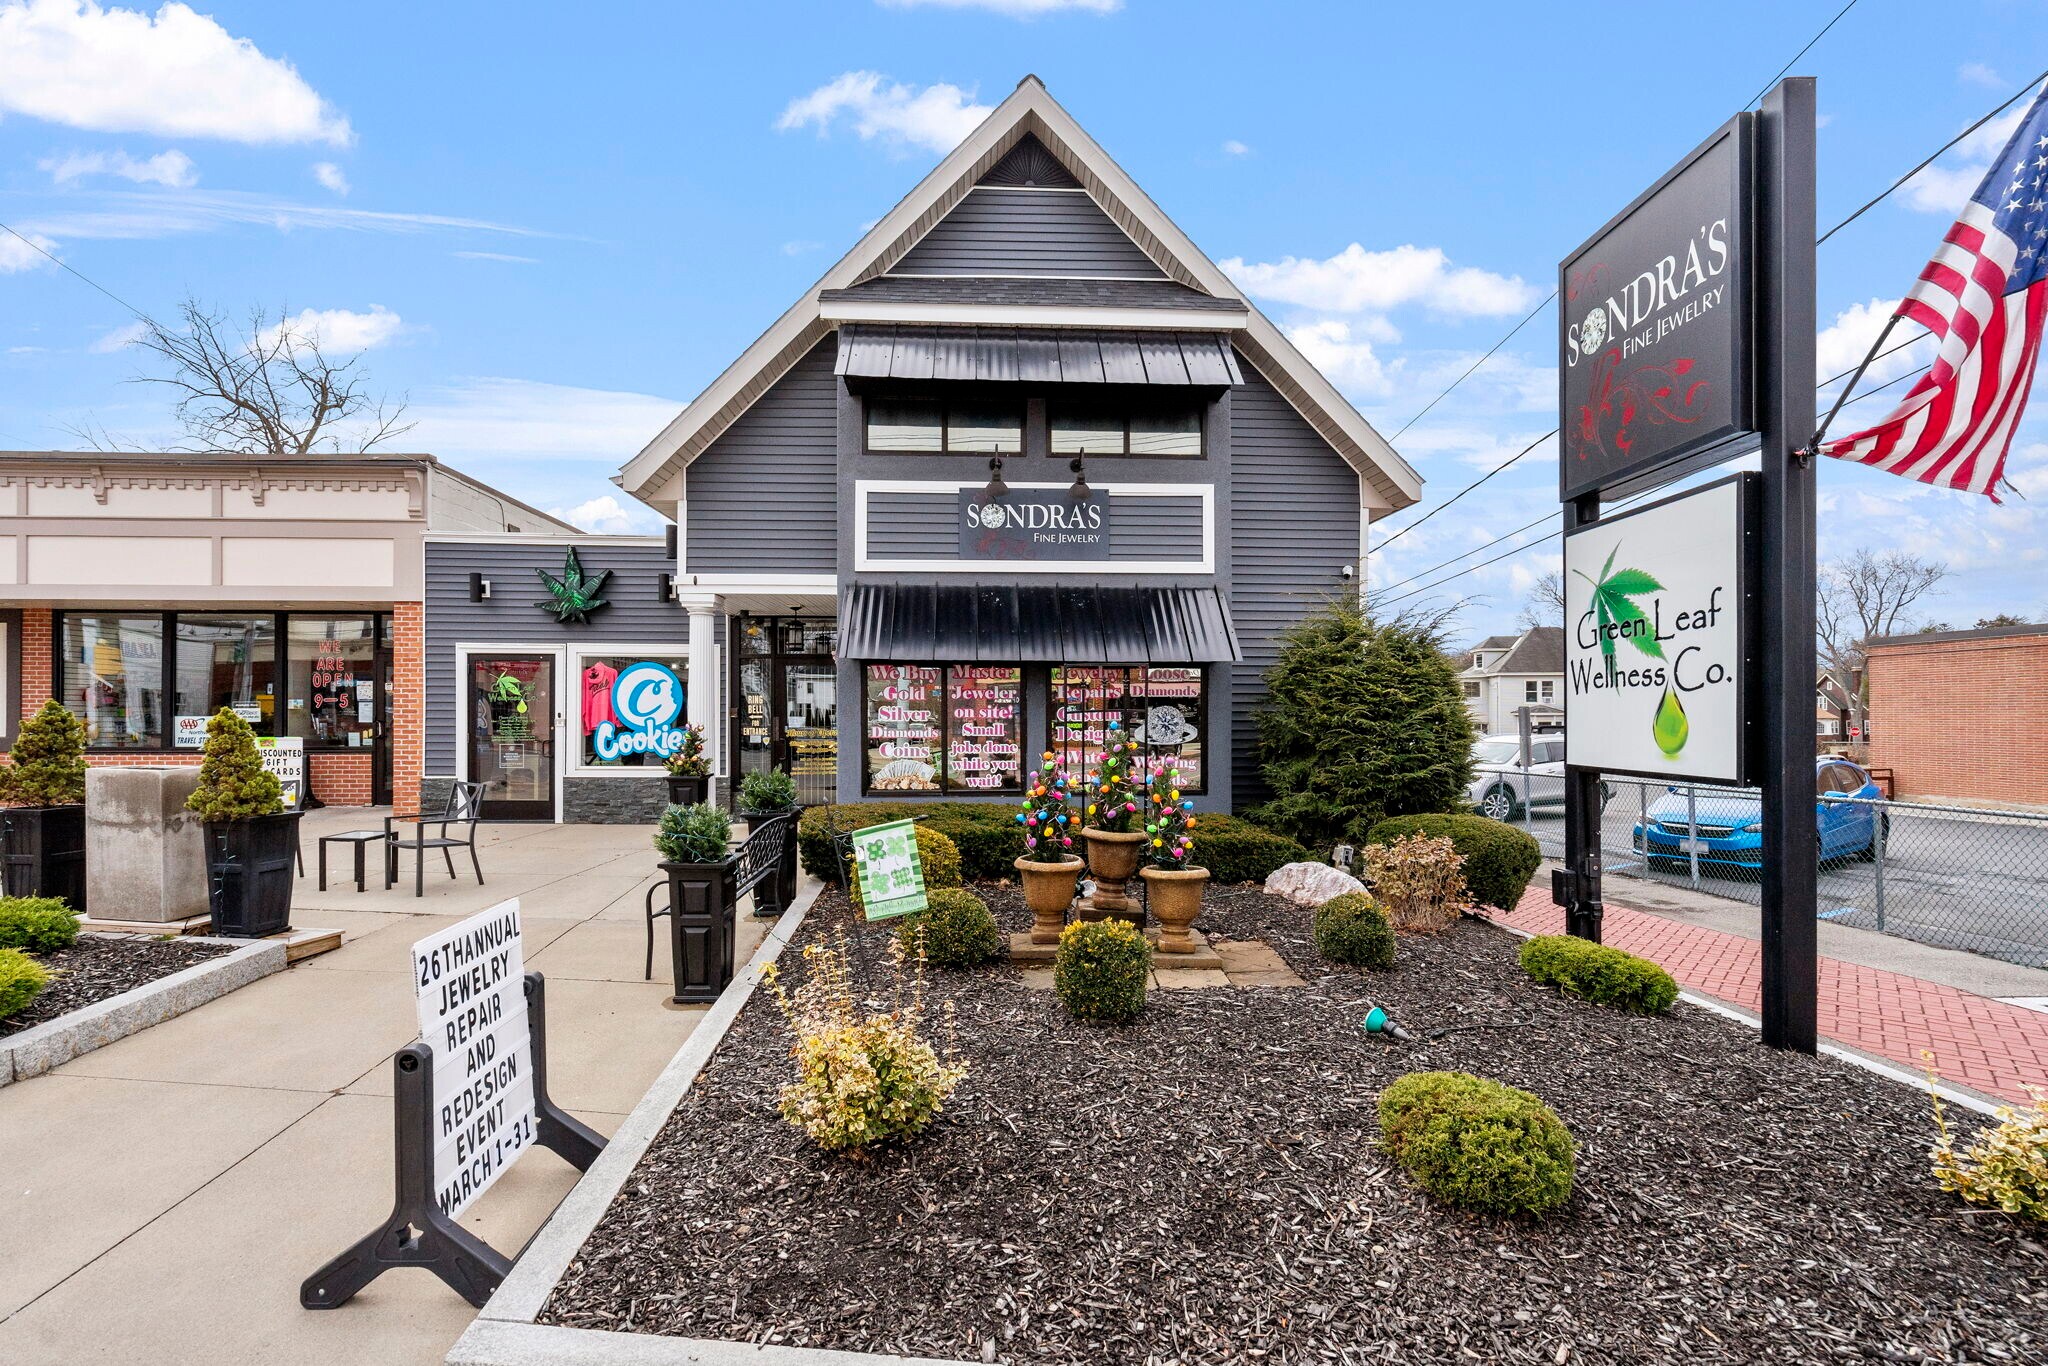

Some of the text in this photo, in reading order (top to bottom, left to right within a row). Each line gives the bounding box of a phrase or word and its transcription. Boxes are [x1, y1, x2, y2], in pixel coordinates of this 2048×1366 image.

[1567, 217, 1728, 368] SONDRA'S
[1623, 284, 1725, 359] FINE JEWELRY
[966, 502, 1101, 530] SONDRA'S
[1033, 532, 1101, 545] FINE JEWELRY
[1577, 586, 1722, 649] Green Leaf
[319, 640, 343, 654] WE
[316, 656, 346, 671] ARE
[1570, 646, 1733, 695] Wellness Co.
[312, 672, 354, 688] OPEN
[870, 664, 941, 683] We Buy
[952, 664, 1015, 680] Master
[1056, 664, 1122, 682] Jewelry
[1138, 665, 1192, 681] Loose
[883, 686, 925, 701] Gold
[951, 685, 1018, 700] Jeweler
[1055, 685, 1122, 703] Repairs
[1131, 685, 1198, 697] Damonds
[747, 694, 764, 705] RING
[747, 704, 764, 714] BELL
[878, 705, 931, 722] Silver
[954, 704, 1014, 719] on site!
[1056, 706, 1122, 722] Custom
[742, 727, 769, 736] ENTRANCE
[871, 725, 940, 739] Diamonds
[961, 722, 1005, 737] Small
[595, 717, 685, 759] Cookie
[259, 749, 302, 757] ISCOUNTED
[878, 741, 931, 759] Coins
[950, 740, 1019, 755] jobs done
[266, 758, 288, 767] GIFT
[950, 757, 1018, 774] while you
[1131, 755, 1198, 771] Weding
[966, 774, 1003, 788] wait!
[439, 950, 509, 1016] JEWELRY
[446, 992, 502, 1053] REPAIR
[467, 1033, 496, 1078] AND
[441, 1053, 517, 1137] REDESIGN
[456, 1098, 504, 1166] EVENT
[440, 1113, 531, 1216] MARCH 1-31
